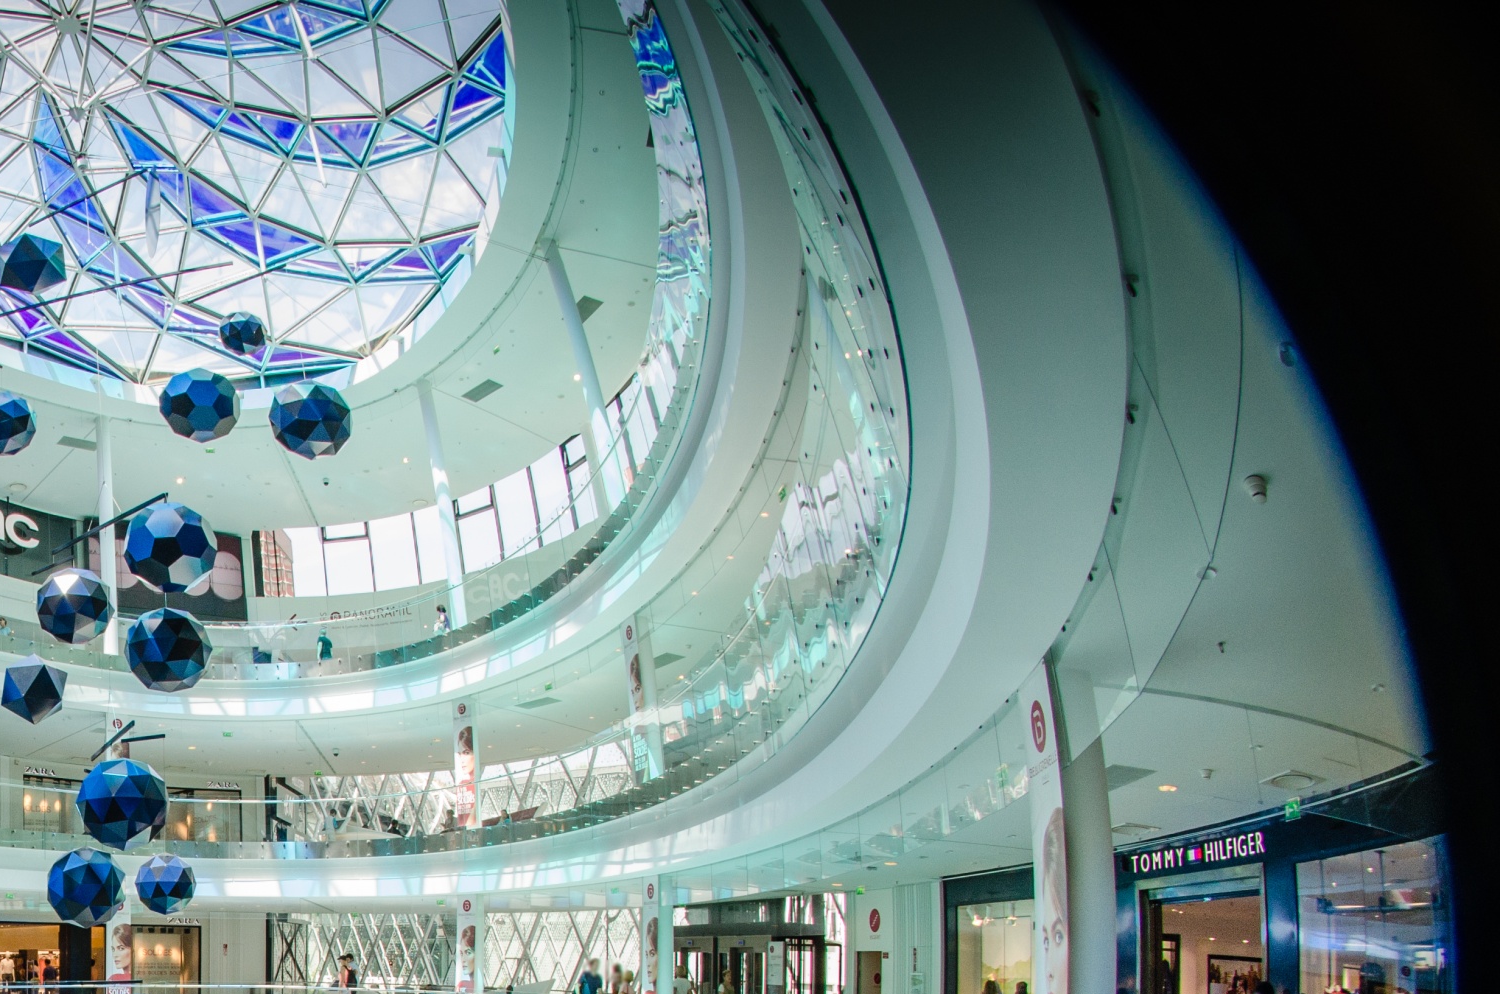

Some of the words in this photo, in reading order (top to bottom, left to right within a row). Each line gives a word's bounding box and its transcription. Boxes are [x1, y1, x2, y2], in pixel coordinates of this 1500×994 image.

[24, 766, 56, 776] ZARA
[207, 781, 240, 790] ZARA
[1131, 847, 1185, 874] TOMMY
[1204, 831, 1266, 863] HILFIGER
[167, 917, 200, 925] ZARA
